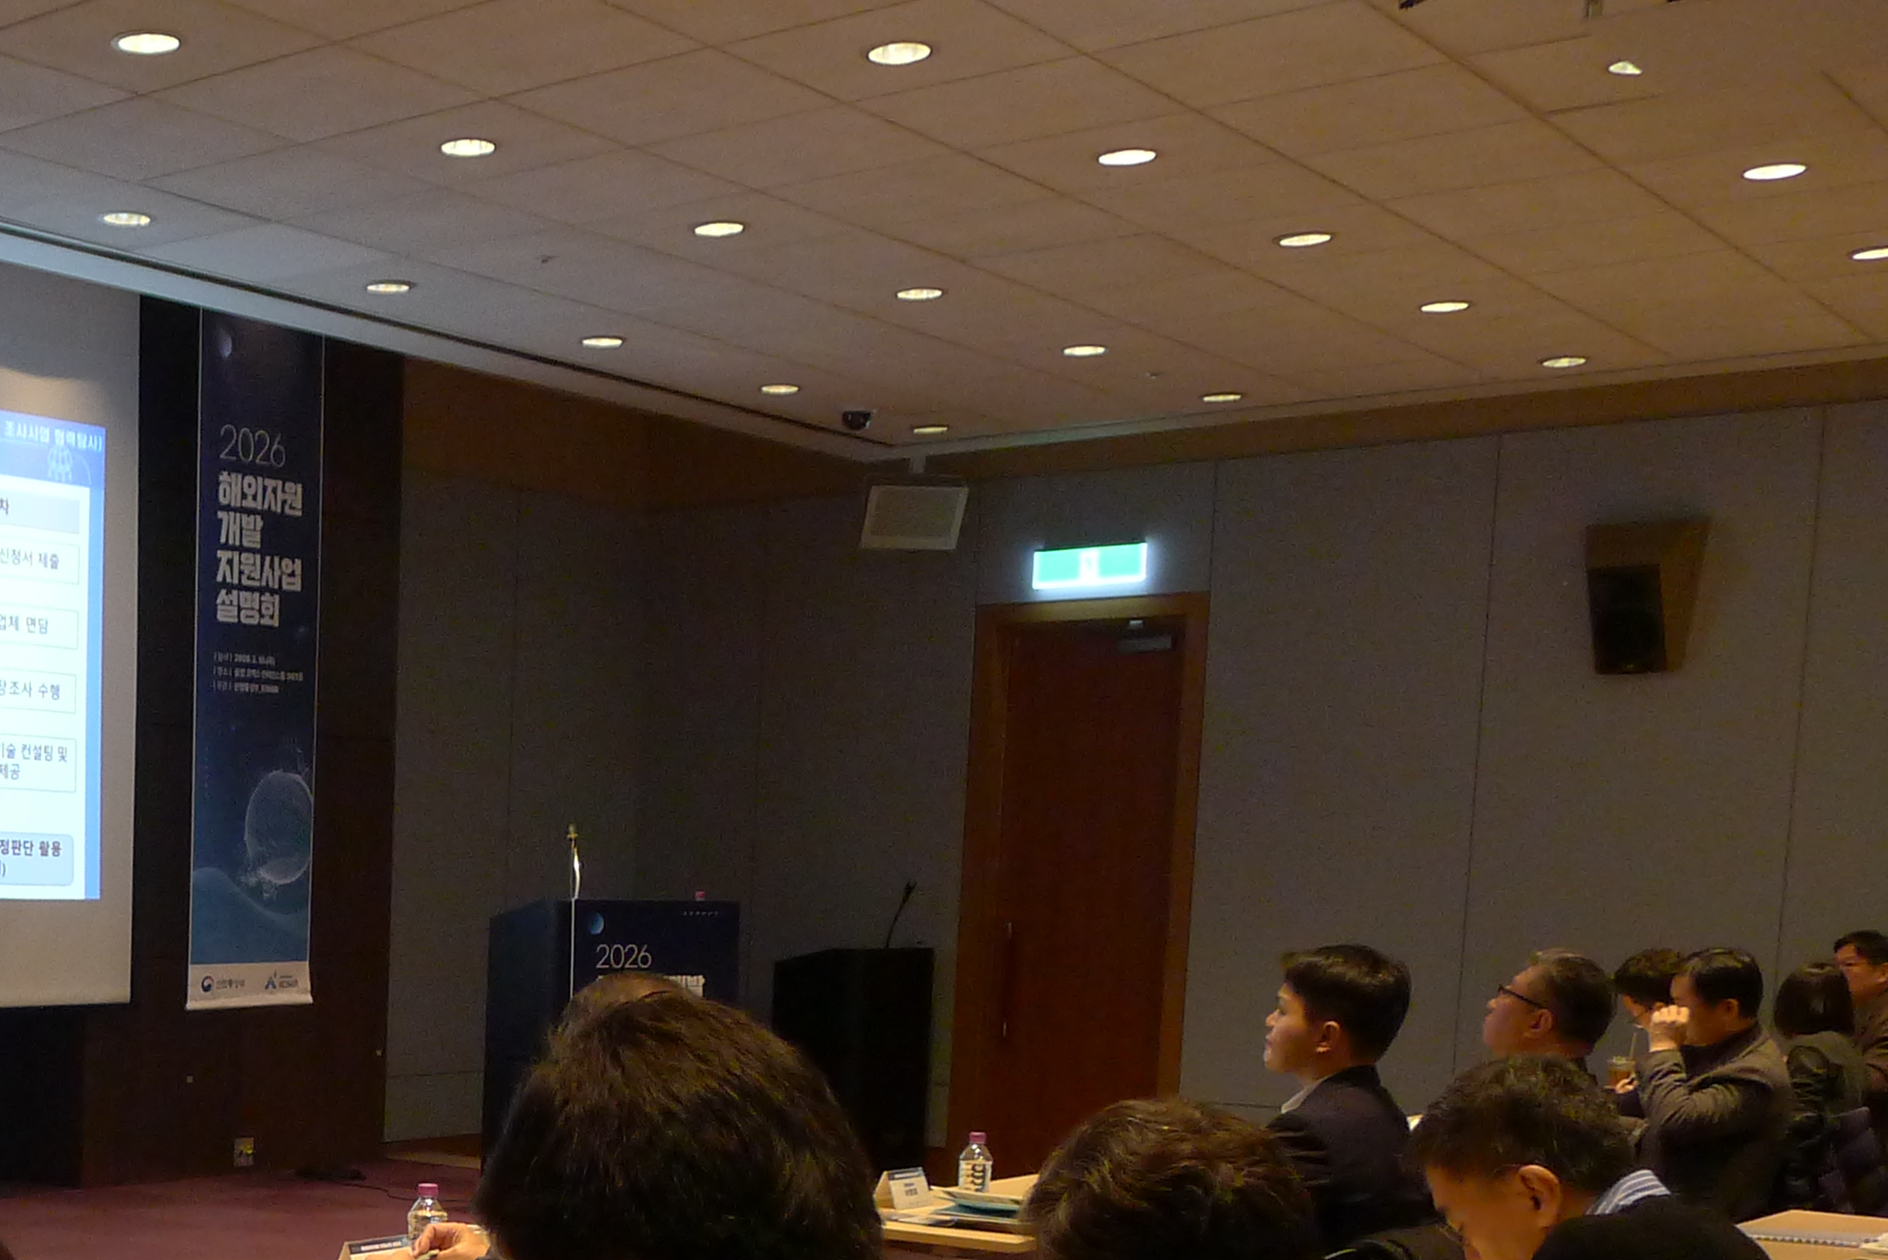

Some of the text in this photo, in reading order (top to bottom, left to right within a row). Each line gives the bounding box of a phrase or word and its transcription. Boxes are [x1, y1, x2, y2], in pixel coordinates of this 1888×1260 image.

[219, 424, 286, 467] 2026
[218, 471, 303, 517] 해외자원
[217, 510, 263, 549] 개발
[0, 548, 34, 567] 신청서
[37, 552, 60, 571] 제출
[216, 550, 302, 592] 지원사업
[216, 588, 280, 627] 설명회
[26, 617, 49, 635] 면담
[38, 683, 61, 701] 수행
[21, 744, 54, 763] 컨설팅
[58, 745, 68, 763] 및
[38, 840, 63, 858] 활용
[596, 944, 652, 969] 2026
